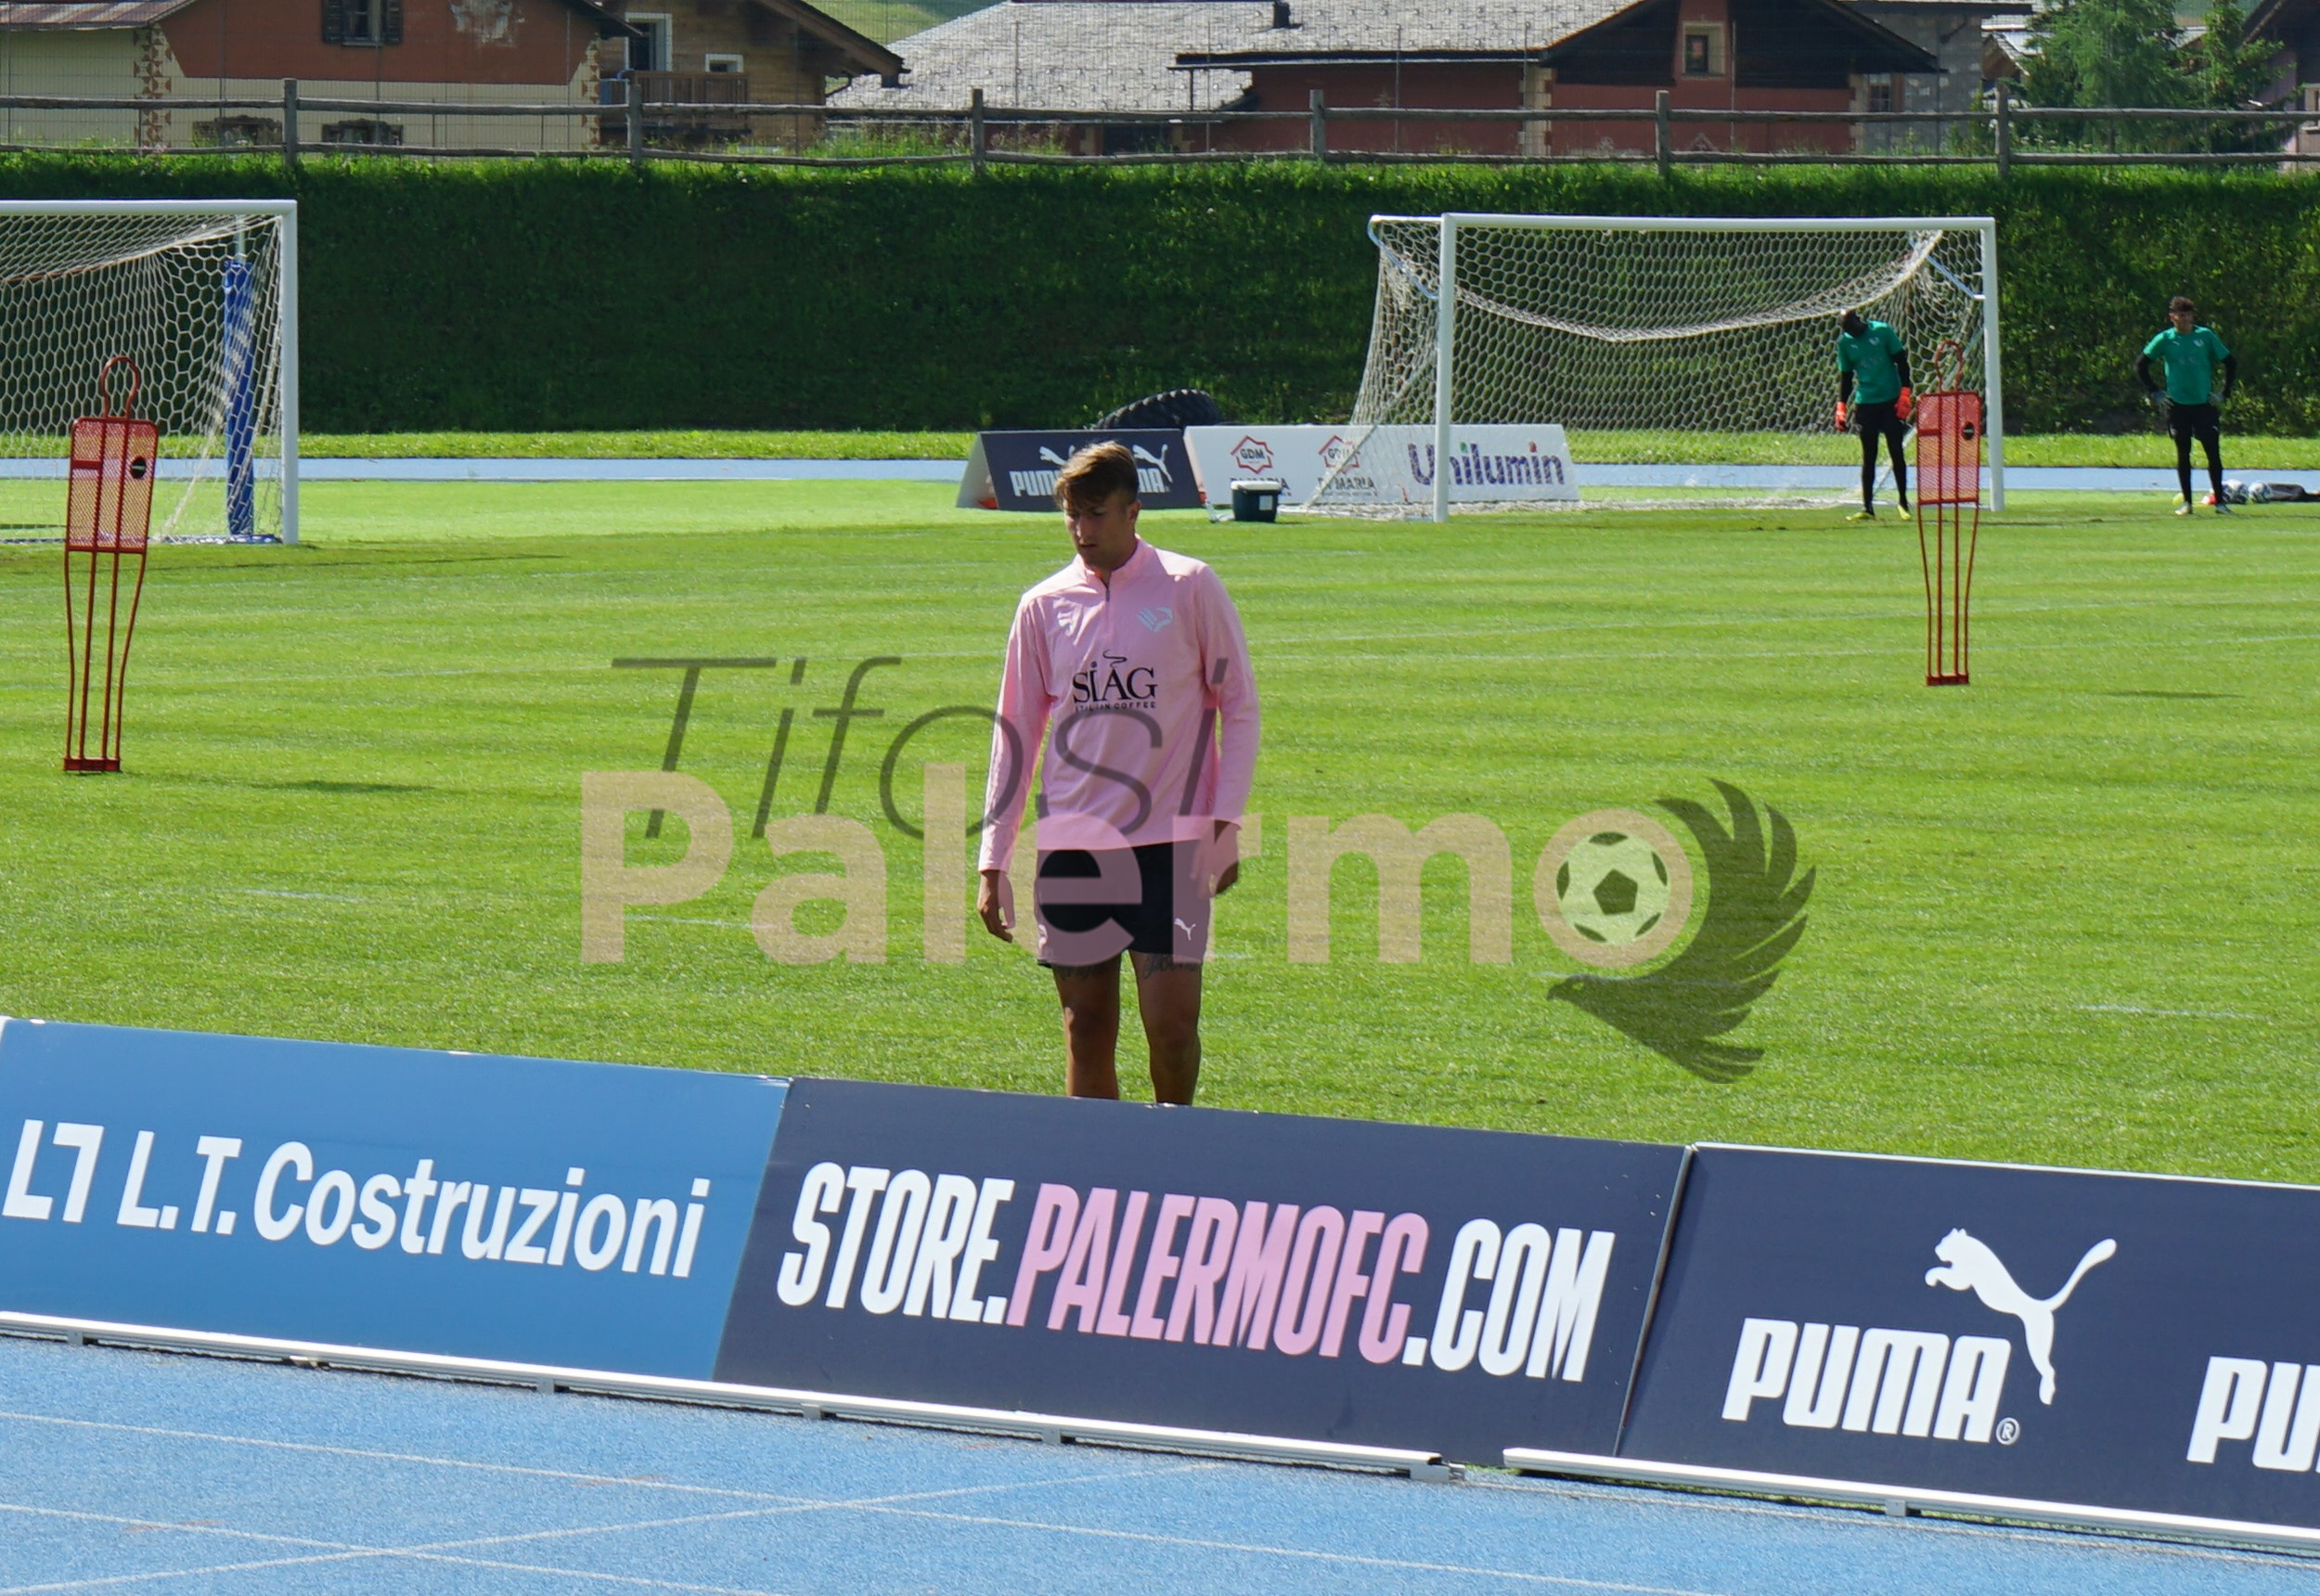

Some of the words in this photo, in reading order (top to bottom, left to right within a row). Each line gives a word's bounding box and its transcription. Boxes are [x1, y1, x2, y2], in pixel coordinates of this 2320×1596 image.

[1009, 470, 1062, 496] PUM
[1239, 447, 1266, 460] GDM
[253, 1141, 710, 1278] Costruzioni
[2186, 1356, 2320, 1474] PU
